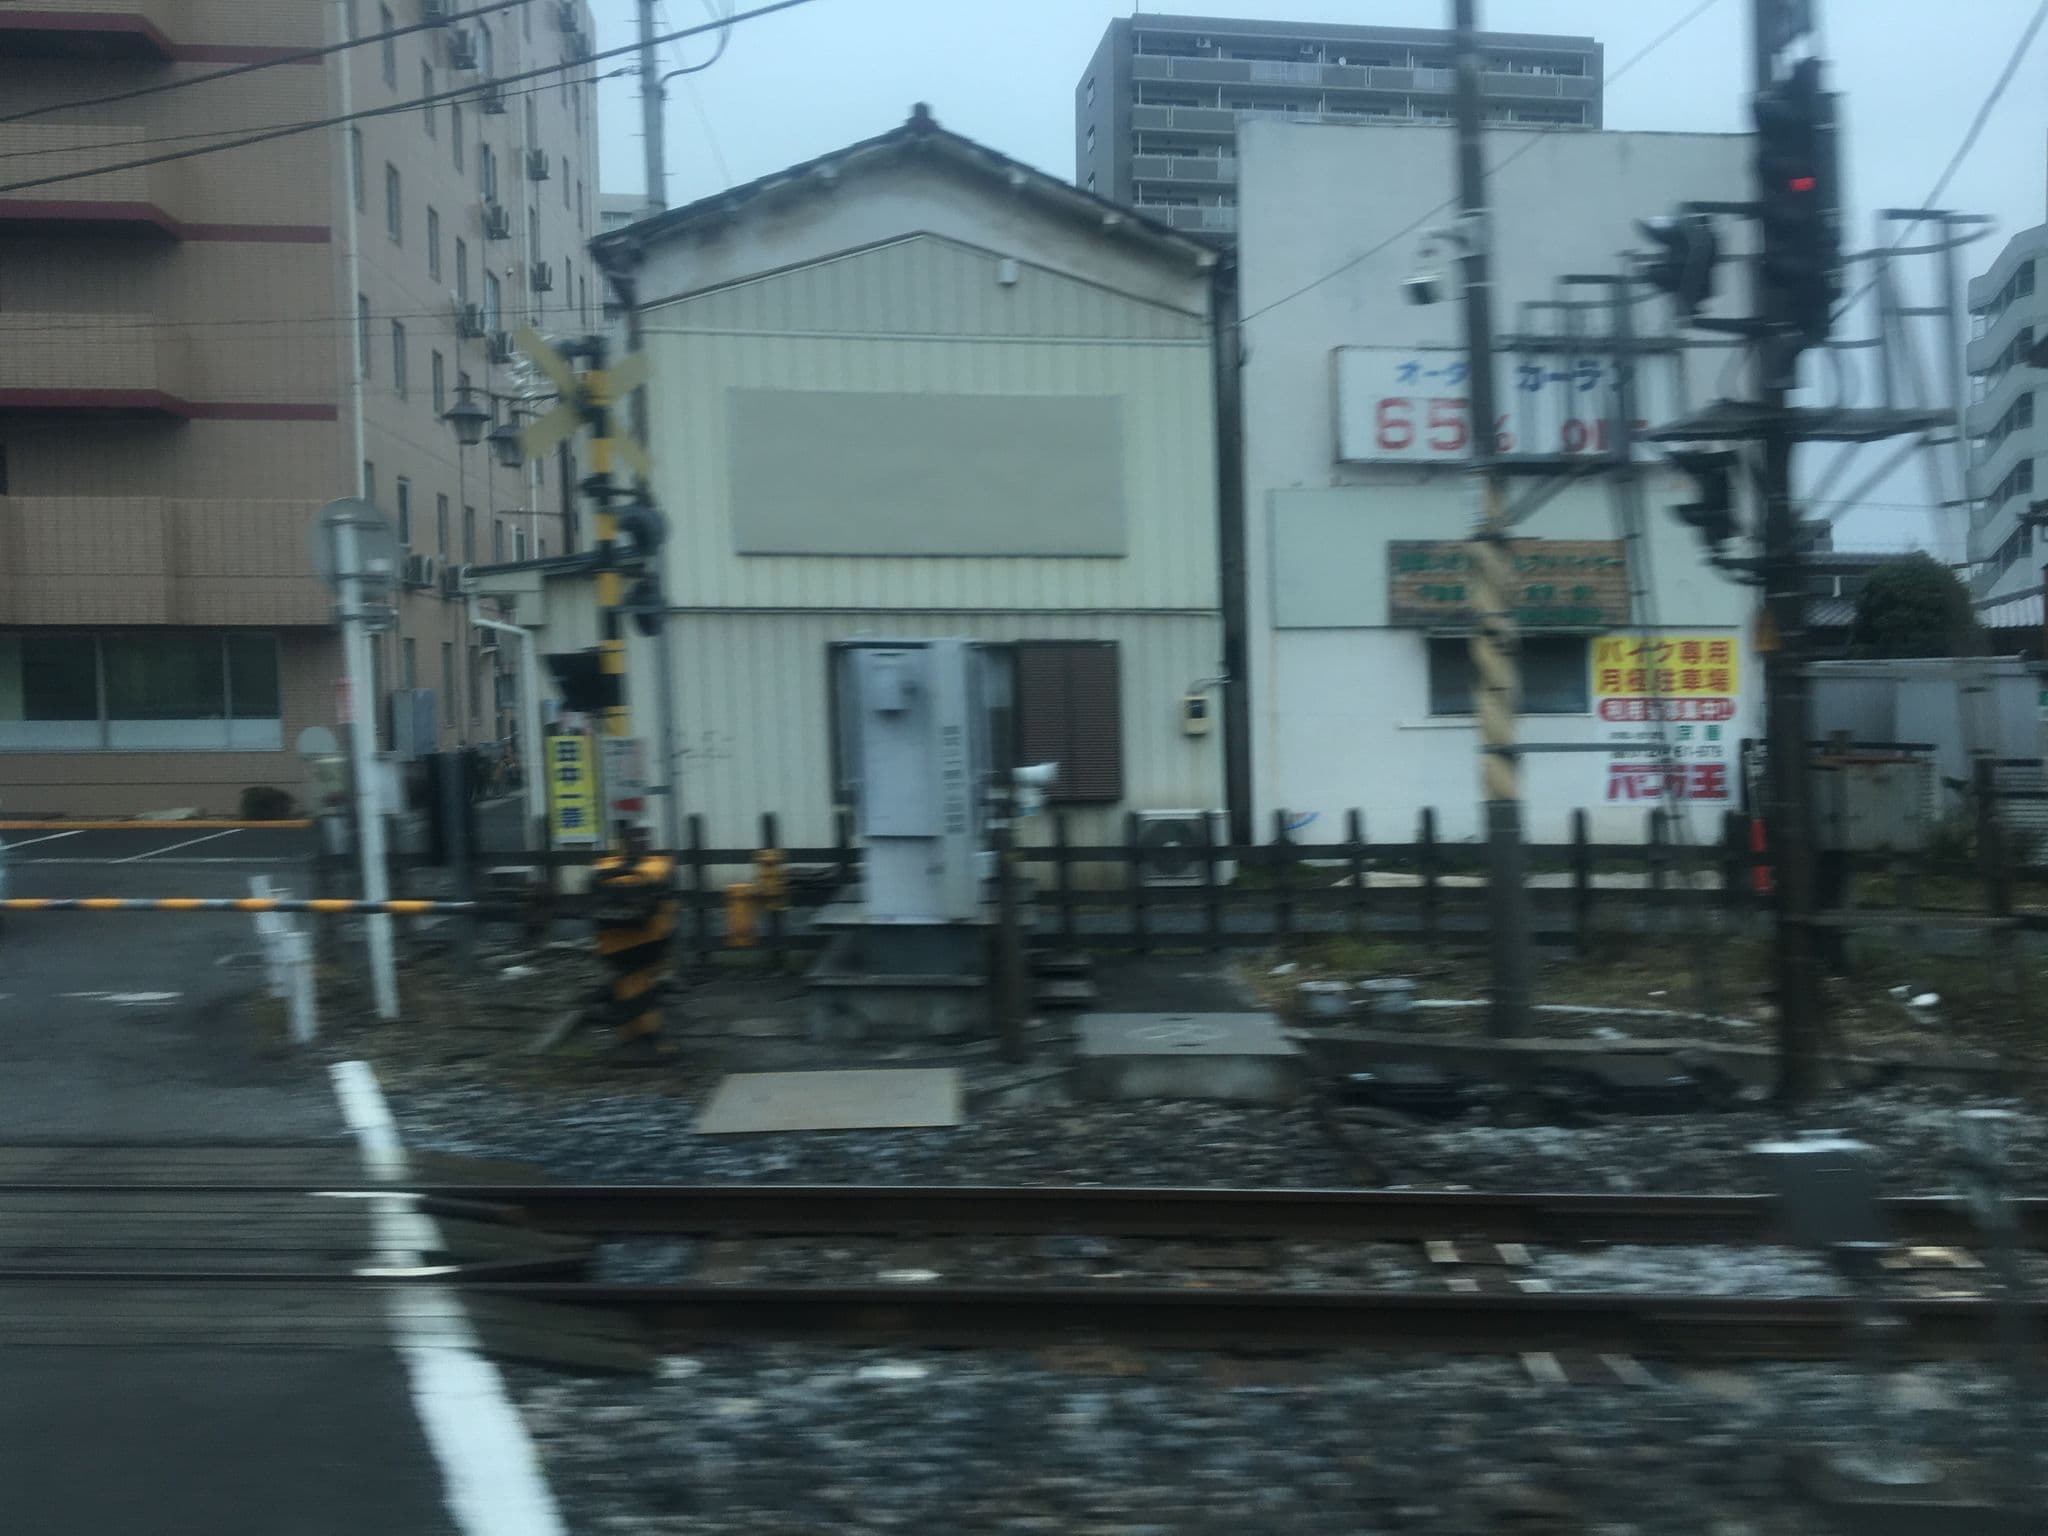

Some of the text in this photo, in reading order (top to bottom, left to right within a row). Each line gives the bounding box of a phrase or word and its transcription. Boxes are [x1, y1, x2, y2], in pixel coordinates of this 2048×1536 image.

[1597, 639, 1730, 665] バイク専用
[1598, 668, 1730, 693] 月極駐車場
